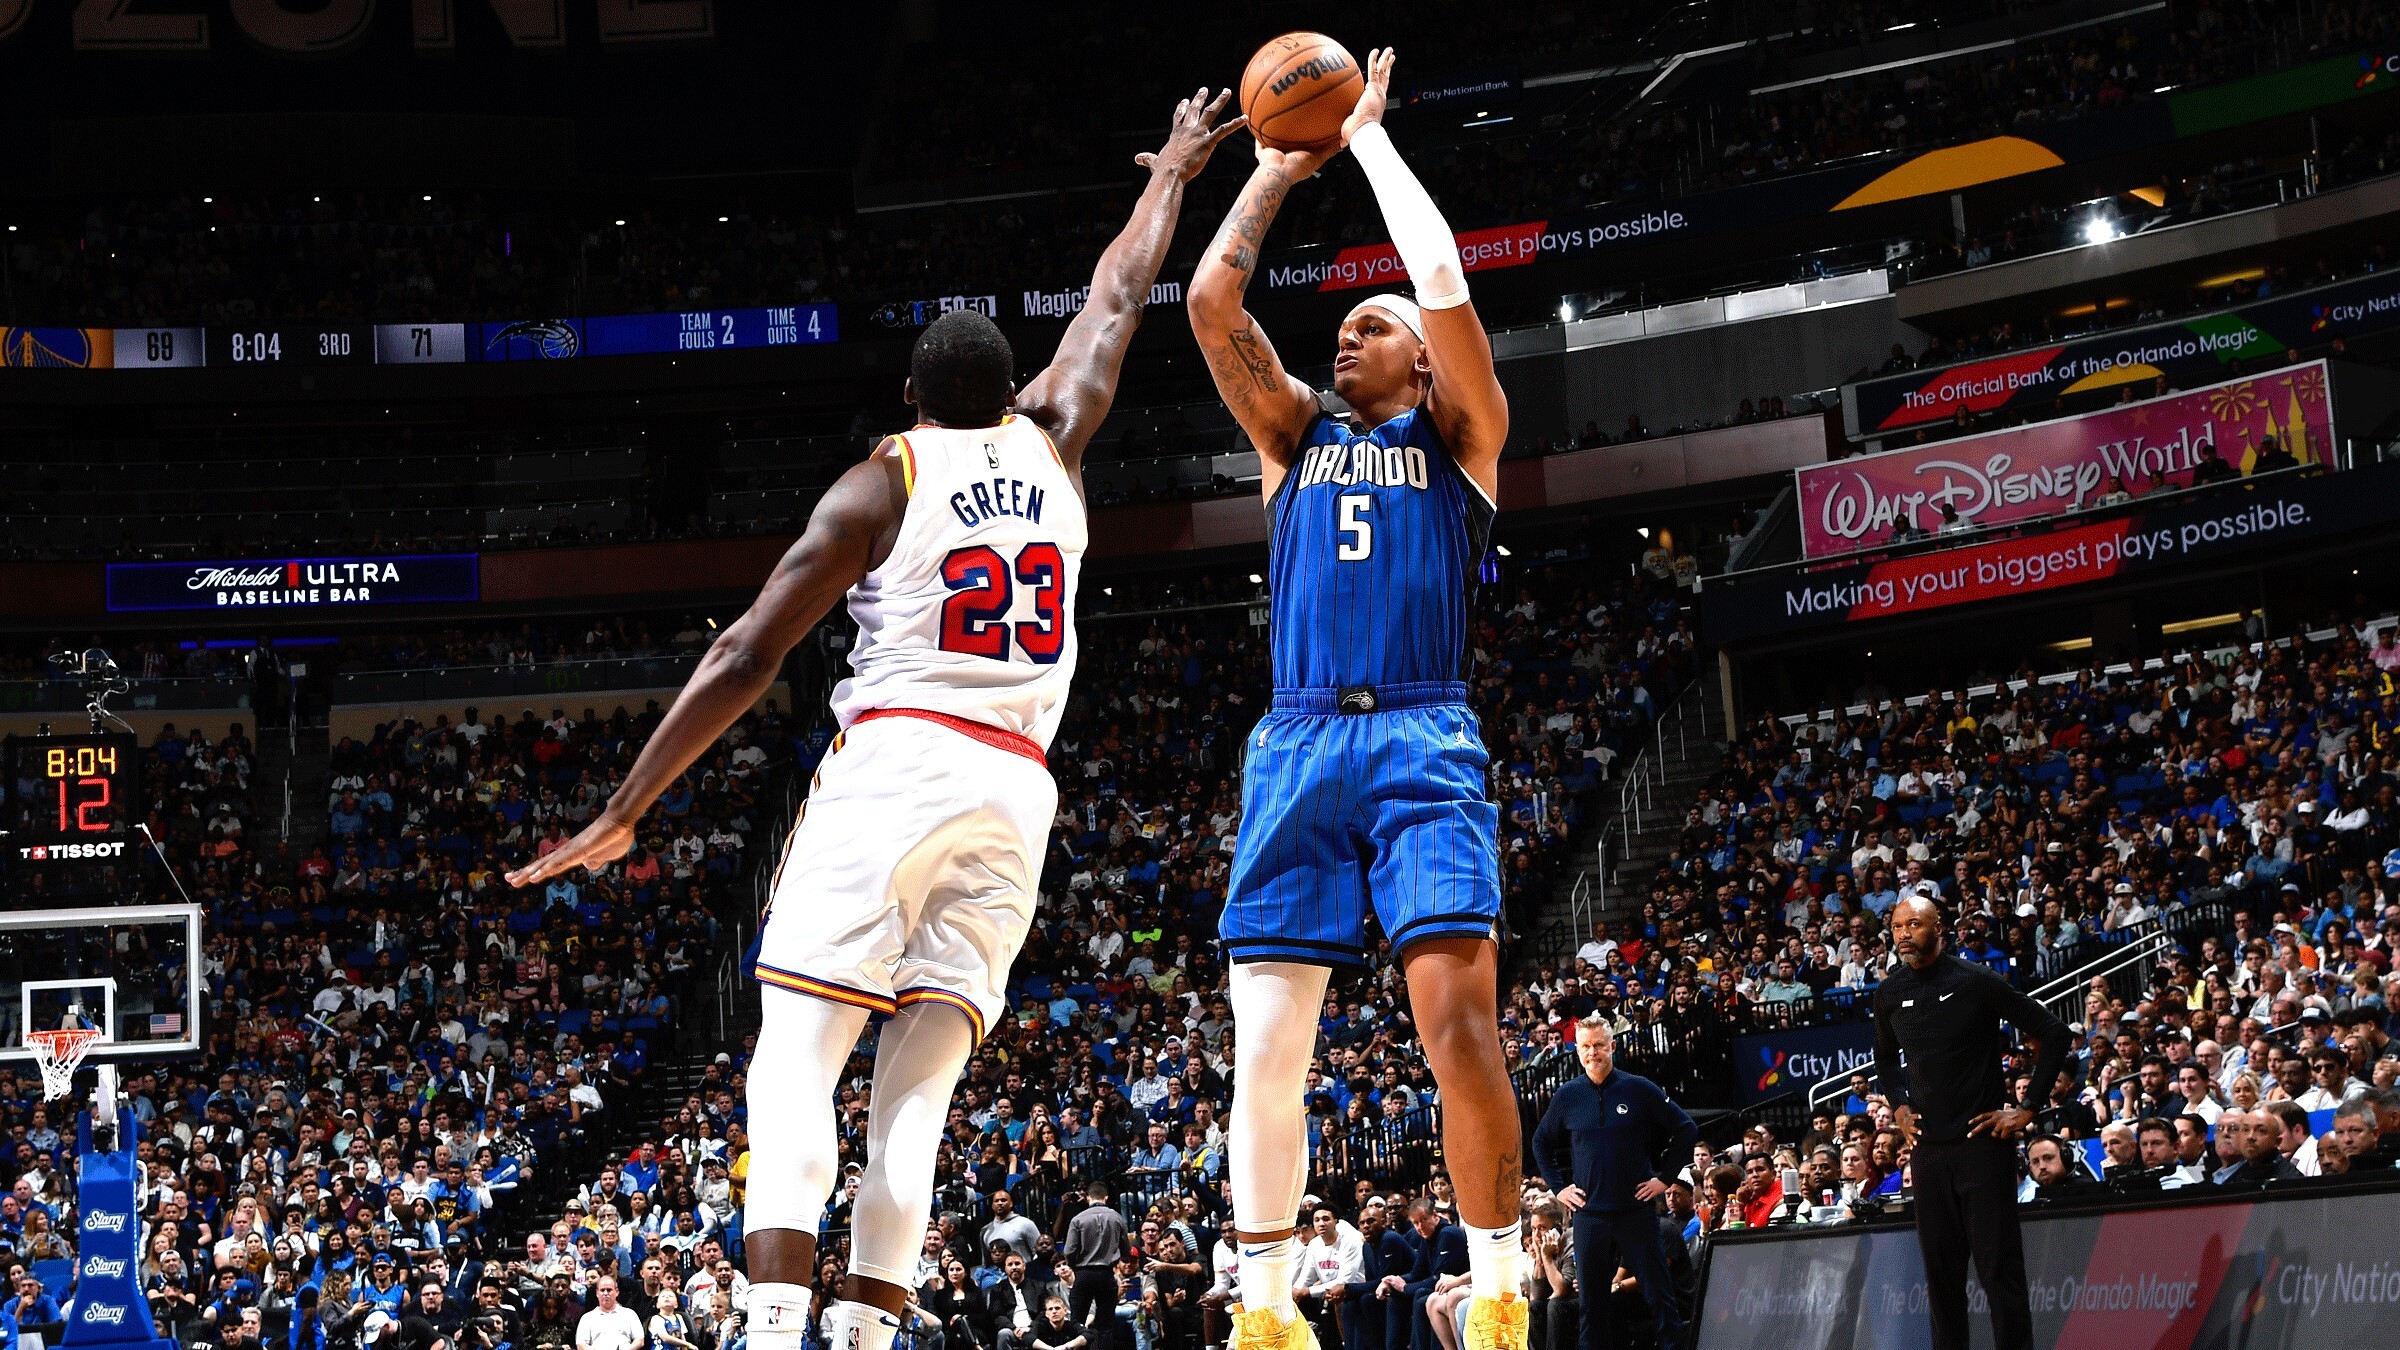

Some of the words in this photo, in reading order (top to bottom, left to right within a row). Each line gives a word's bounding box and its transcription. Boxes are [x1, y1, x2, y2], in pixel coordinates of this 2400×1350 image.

[1271, 53, 1348, 96] Wilson
[1422, 91, 1442, 101] City
[1443, 85, 1484, 97] National
[1485, 80, 1509, 91] Bank
[1269, 257, 1357, 288] Making
[1364, 255, 1406, 284] you
[1518, 229, 1583, 260] plays
[1588, 209, 1689, 248] possible.
[680, 312, 711, 331] TEAM
[767, 307, 796, 326] TIME
[807, 310, 821, 340] 4
[2332, 304, 2365, 321] City
[319, 332, 351, 356] 3RD
[411, 327, 433, 357] 71
[679, 331, 715, 349] FOULS
[721, 315, 735, 345] 2
[767, 326, 797, 345] OUTS
[147, 331, 174, 361] 69
[232, 332, 282, 361] 8:04
[1903, 388, 1936, 410] The
[1939, 376, 2004, 403] Official
[2007, 365, 2055, 391] Bank
[2059, 360, 2080, 381] of
[2082, 355, 2113, 376] the
[2115, 338, 2197, 369] Orlando
[2199, 326, 2259, 354] Magic
[1298, 440, 1428, 491] ORLANDO
[2097, 423, 2215, 482] World
[950, 478, 1045, 528] GREEN
[1338, 494, 1372, 562] 5
[1785, 574, 1896, 616] Making
[1902, 565, 1970, 606] your
[1975, 540, 2089, 587] biggest
[2096, 528, 2173, 576] plays
[2180, 497, 2312, 550] possible.
[186, 566, 283, 590] Michelob
[307, 562, 400, 585] ULTRA
[217, 589, 320, 605] BASELINE
[330, 587, 370, 602] BAR
[938, 542, 1065, 664] 23
[47, 746, 117, 778] 8:04
[60, 777, 111, 832] 12
[48, 842, 125, 860] TISSOT
[1108, 873, 1125, 886] 24
[1788, 1053, 1833, 1081] City
[84, 1209, 126, 1233] Starry
[84, 1255, 126, 1279] Starry
[1881, 1284, 1905, 1315] The
[2029, 1277, 2057, 1312] the
[2059, 1273, 2133, 1312] Orlando
[2136, 1271, 2198, 1321] Magic
[2278, 1264, 2331, 1318] City
[84, 1301, 126, 1325] Starry
